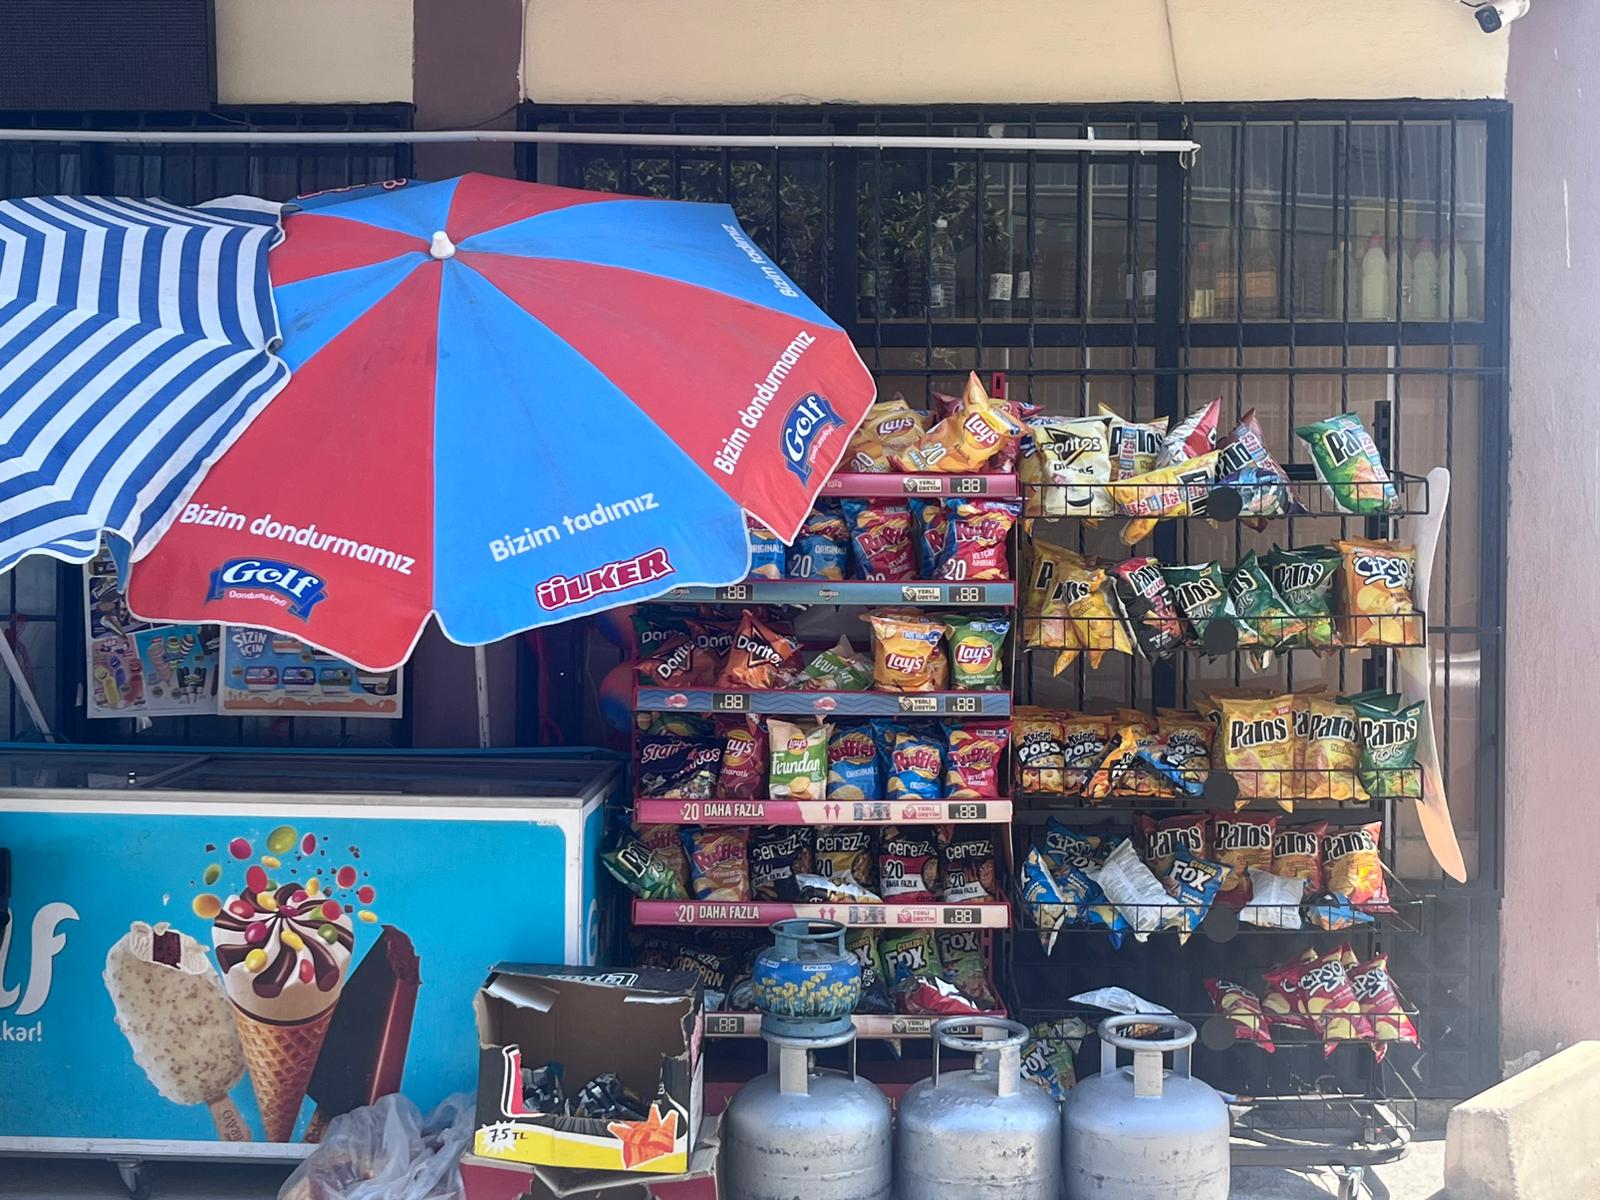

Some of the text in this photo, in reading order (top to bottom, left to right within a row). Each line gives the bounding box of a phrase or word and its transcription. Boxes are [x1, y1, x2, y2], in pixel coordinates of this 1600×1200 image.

[713, 330, 817, 476] Bizim dondurmamız
[785, 395, 827, 462] Golf
[180, 503, 416, 575] Bizim dondurmamız
[488, 492, 660, 563] Bizim tadımız
[790, 554, 813, 578] 20
[944, 558, 967, 580] 20
[222, 561, 320, 598] Golf
[535, 547, 676, 611] ÜLKER
[886, 652, 925, 673] Lay's
[957, 644, 993, 665] Lay's
[704, 803, 732, 817] DAHA
[734, 803, 765, 817] FAZLA
[1169, 860, 1212, 892] FOX
[699, 905, 727, 919] DAHA
[729, 905, 760, 919] FAZLA
[0, 1020, 43, 1042] kar!
[512, 1131, 528, 1141] TL
